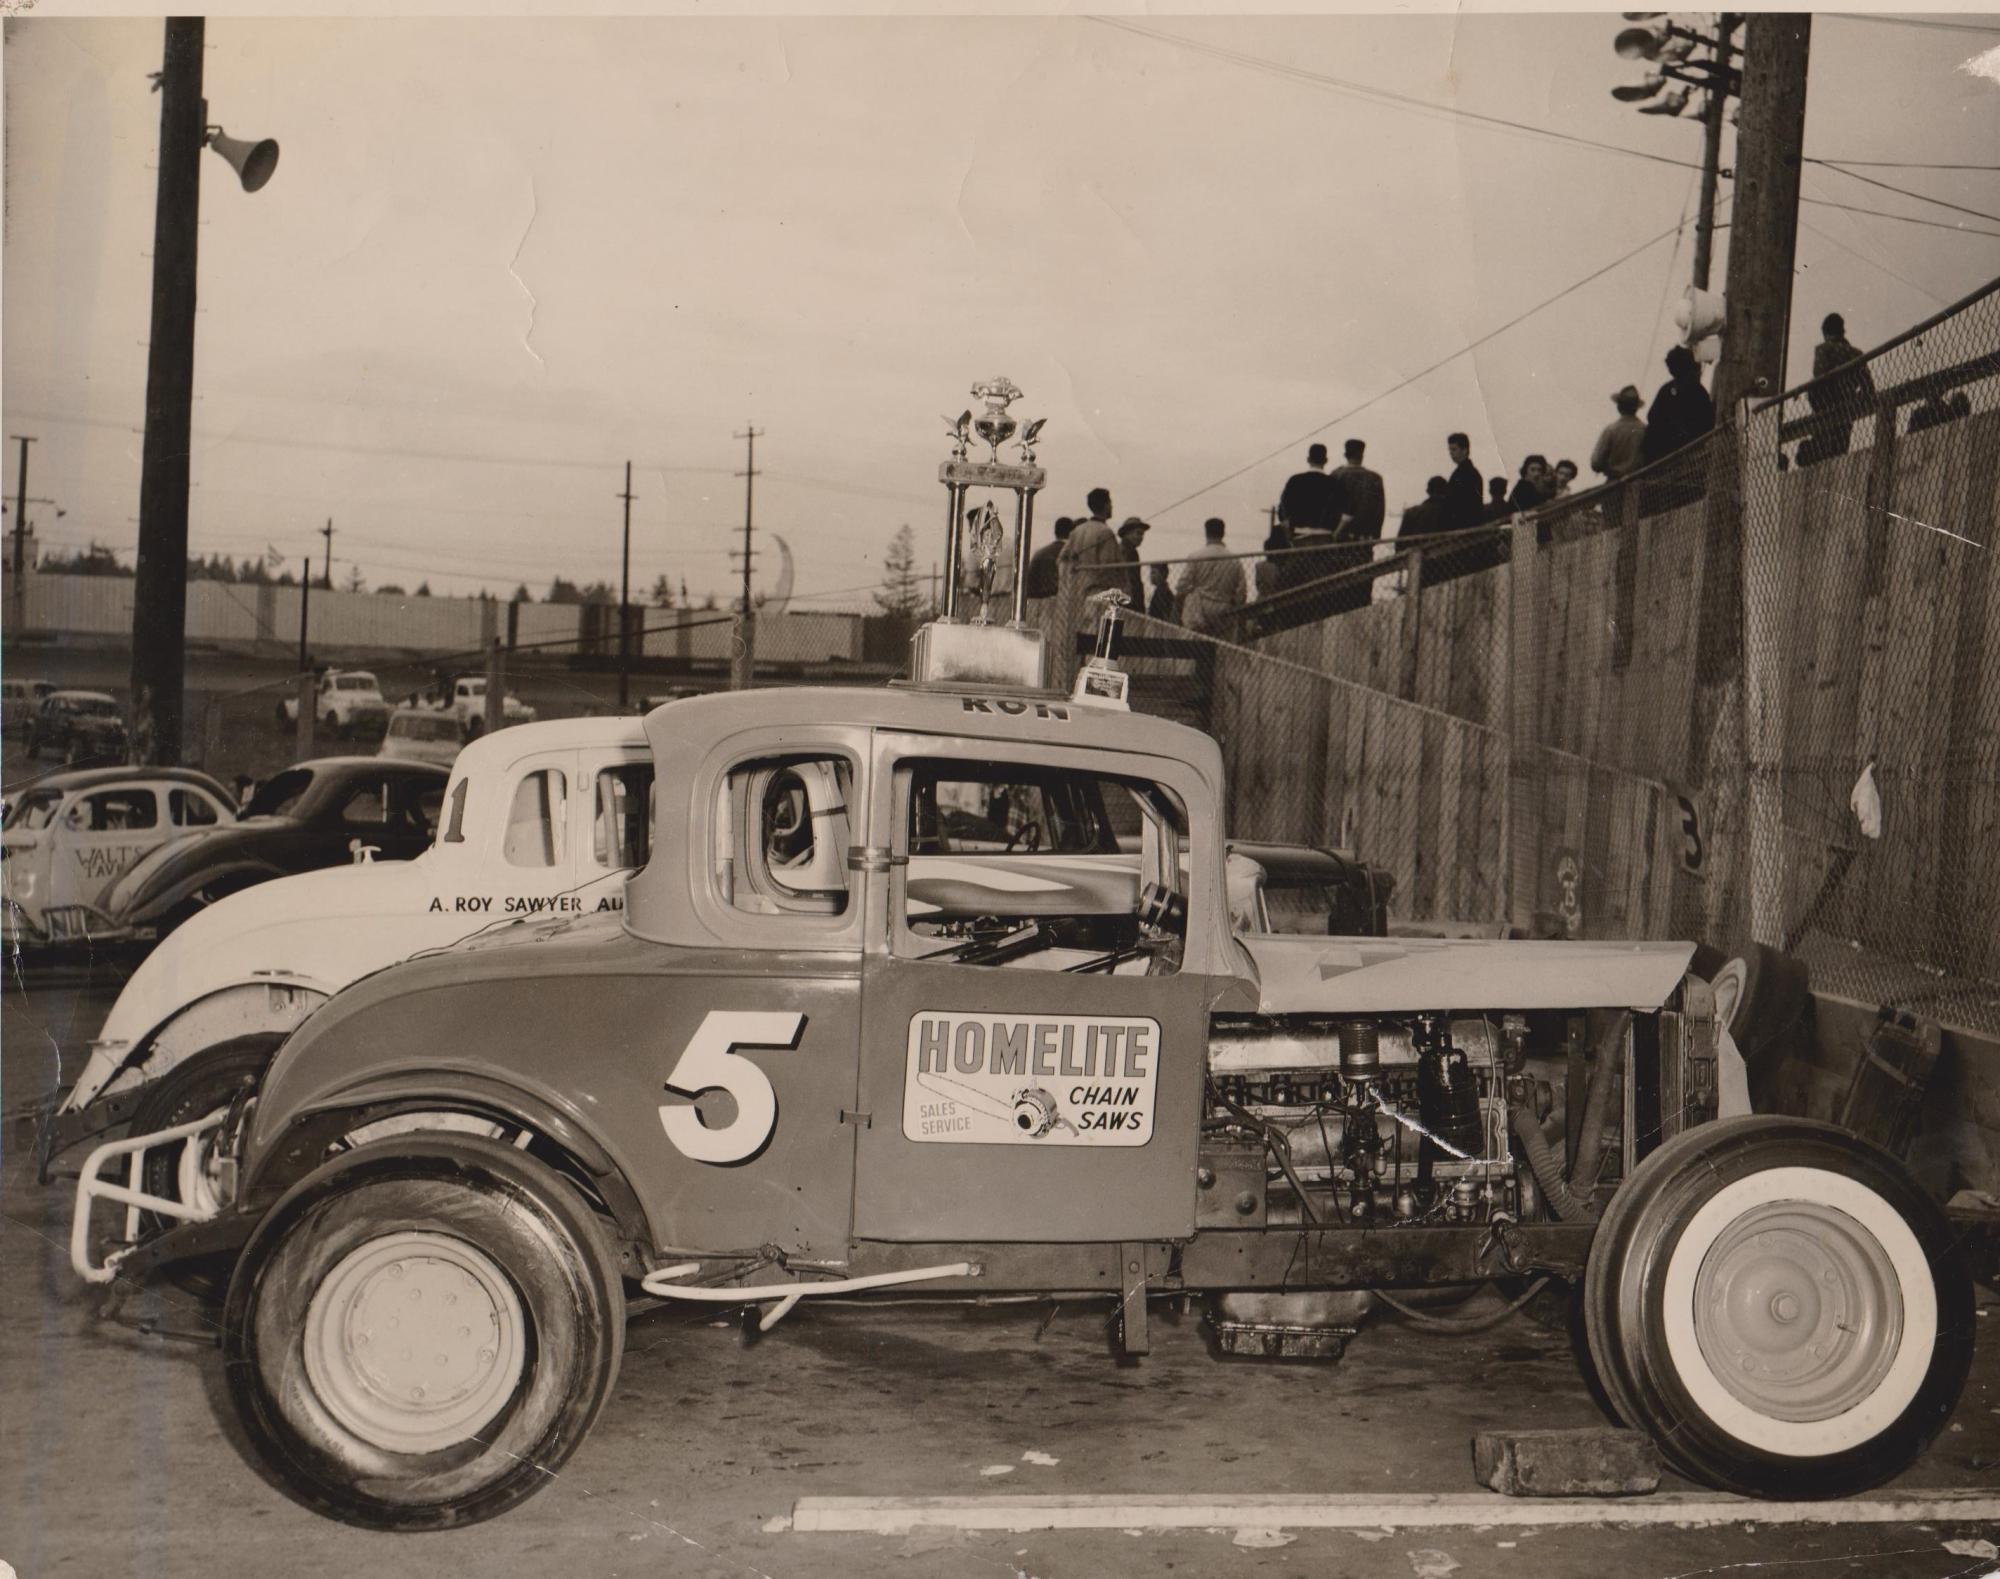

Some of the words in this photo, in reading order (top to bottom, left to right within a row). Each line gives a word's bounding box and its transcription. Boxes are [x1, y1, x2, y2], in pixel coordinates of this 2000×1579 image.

[444, 777, 468, 843] 1
[429, 898, 449, 912] A.
[455, 897, 493, 912] ROY
[504, 897, 582, 912] SAWYER
[918, 1020, 1150, 1078] HOMELITE
[658, 1010, 809, 1168] 5
[1069, 1086, 1139, 1106] CHAIN
[919, 1102, 956, 1119] SALES
[1078, 1111, 1144, 1130] SAWS
[921, 1116, 972, 1136] SERVICE
